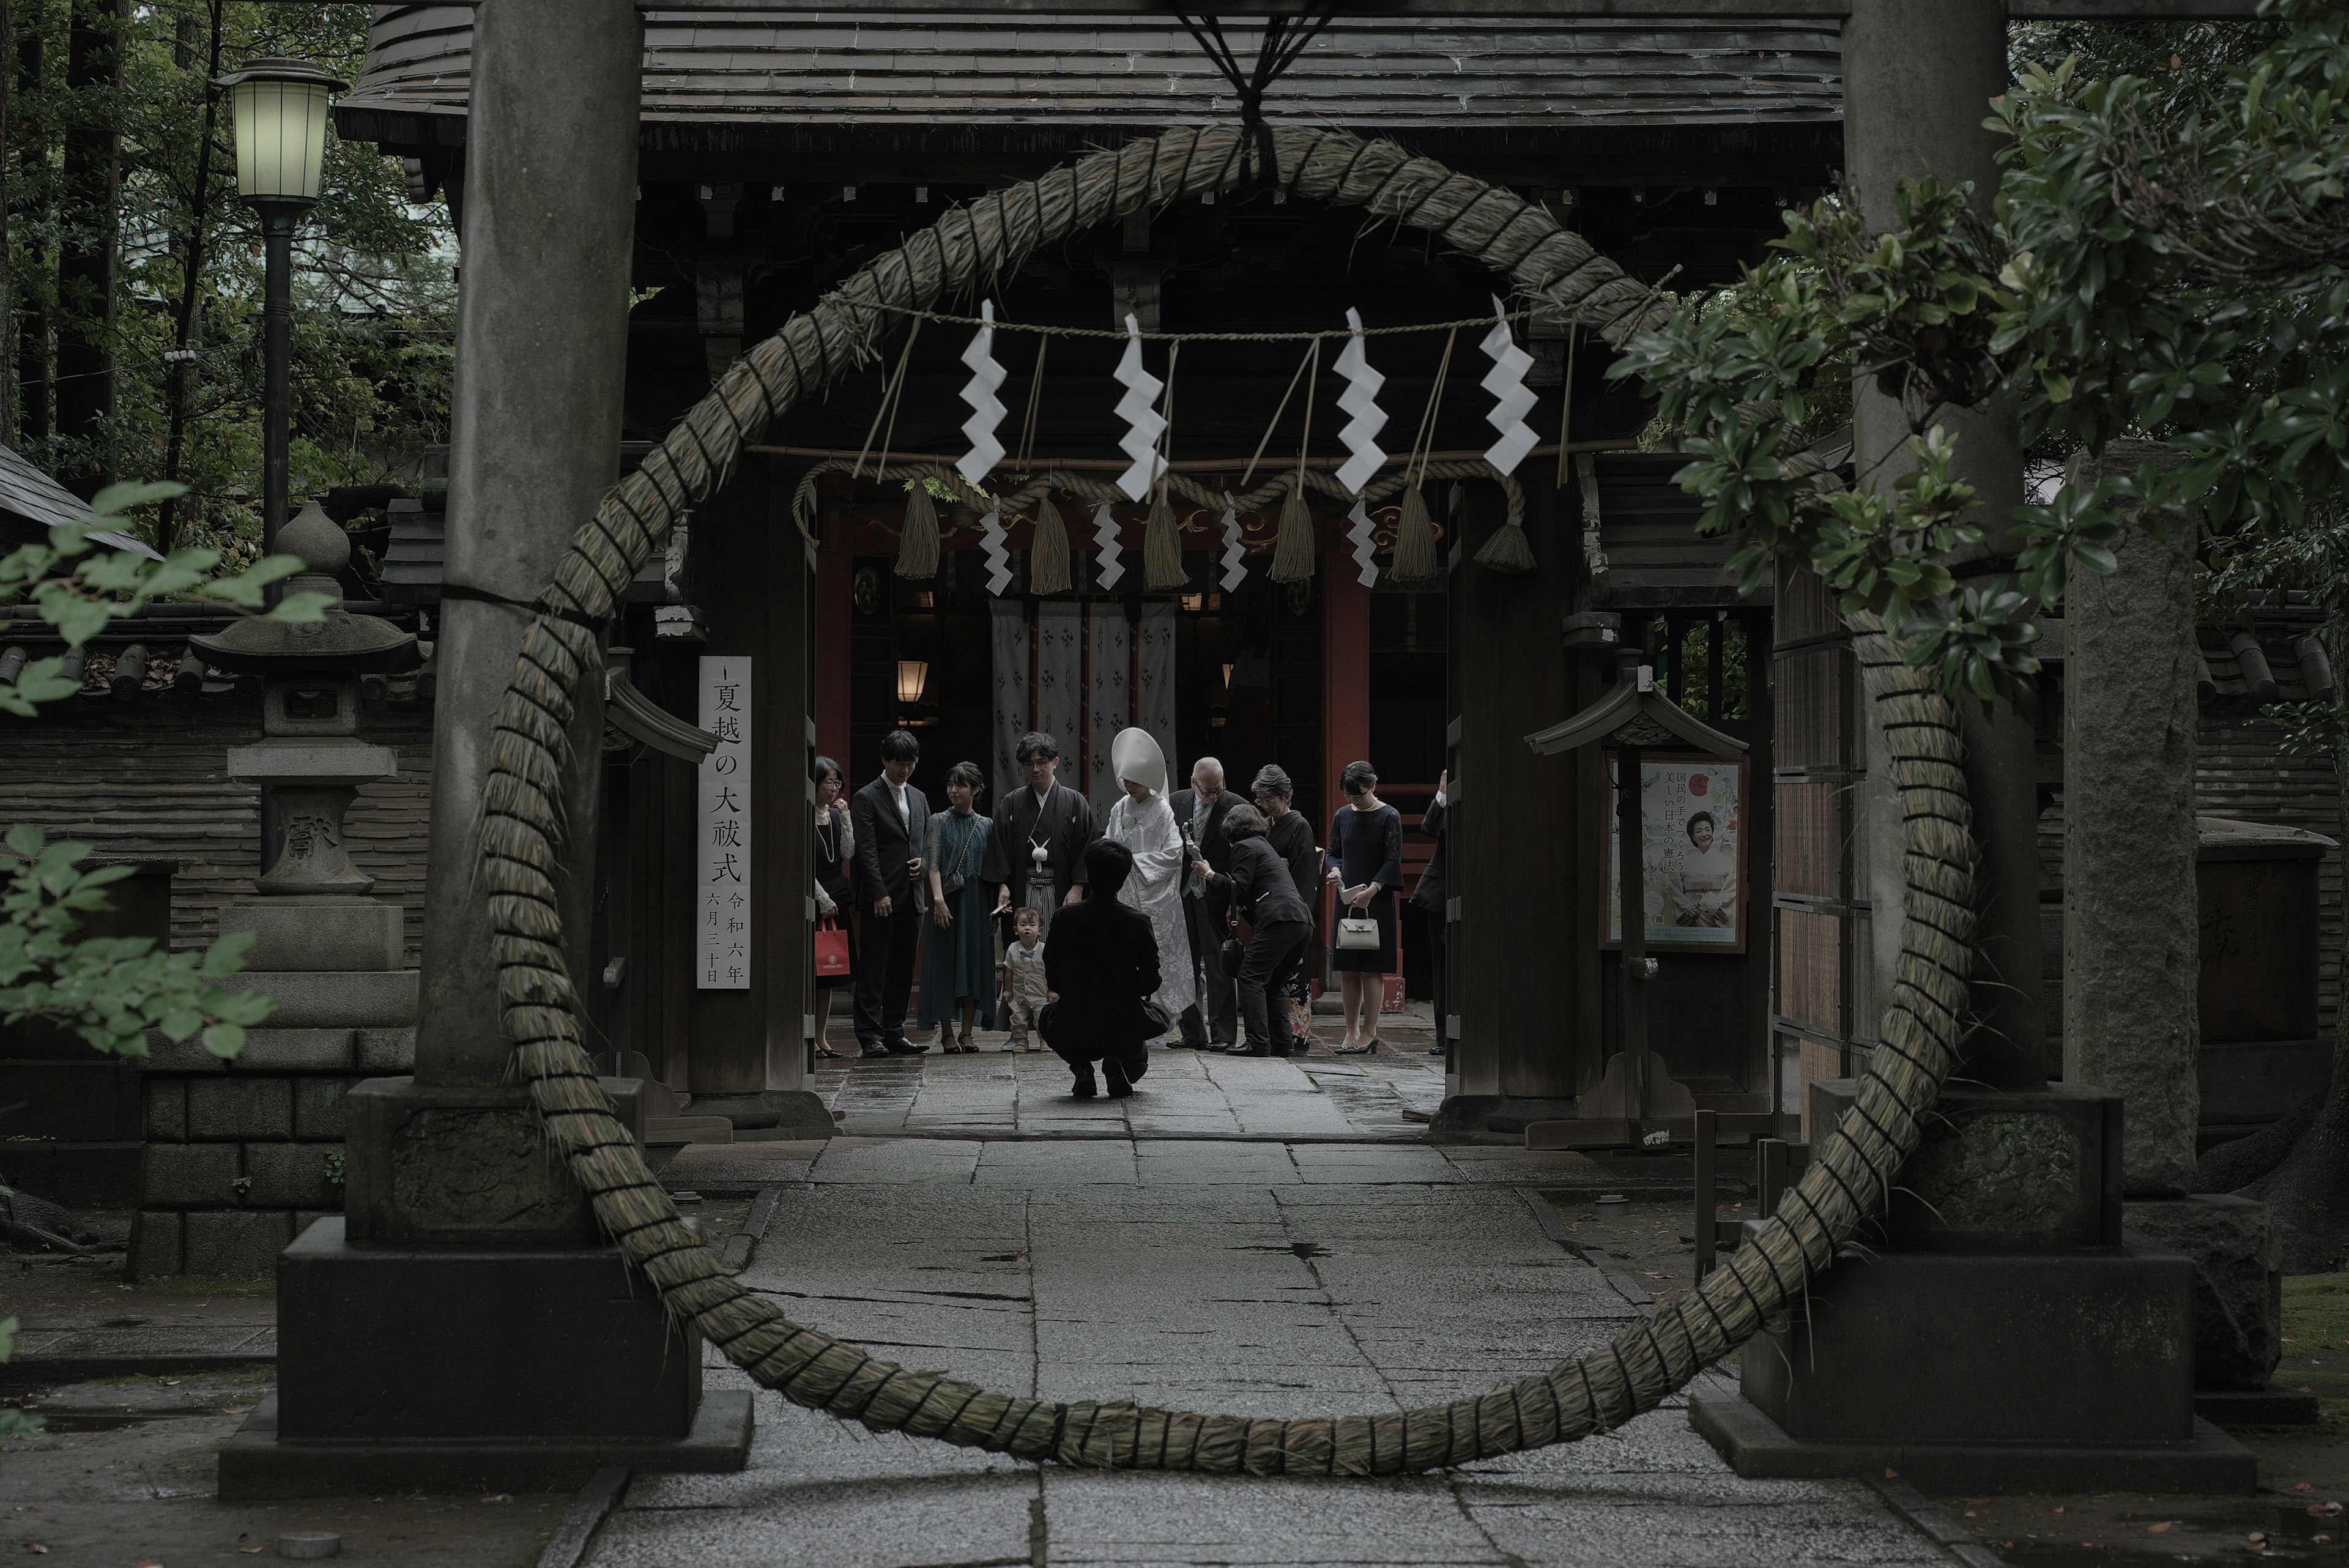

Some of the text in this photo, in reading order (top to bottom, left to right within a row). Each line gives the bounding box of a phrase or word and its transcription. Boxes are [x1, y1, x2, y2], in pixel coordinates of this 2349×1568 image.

[1663, 771, 1675, 872] 美しい日本の憲法
[1675, 772, 1687, 872] 国民の手でつくろう
[705, 892, 721, 983] 六月三十日
[725, 892, 746, 984] 令和六年
